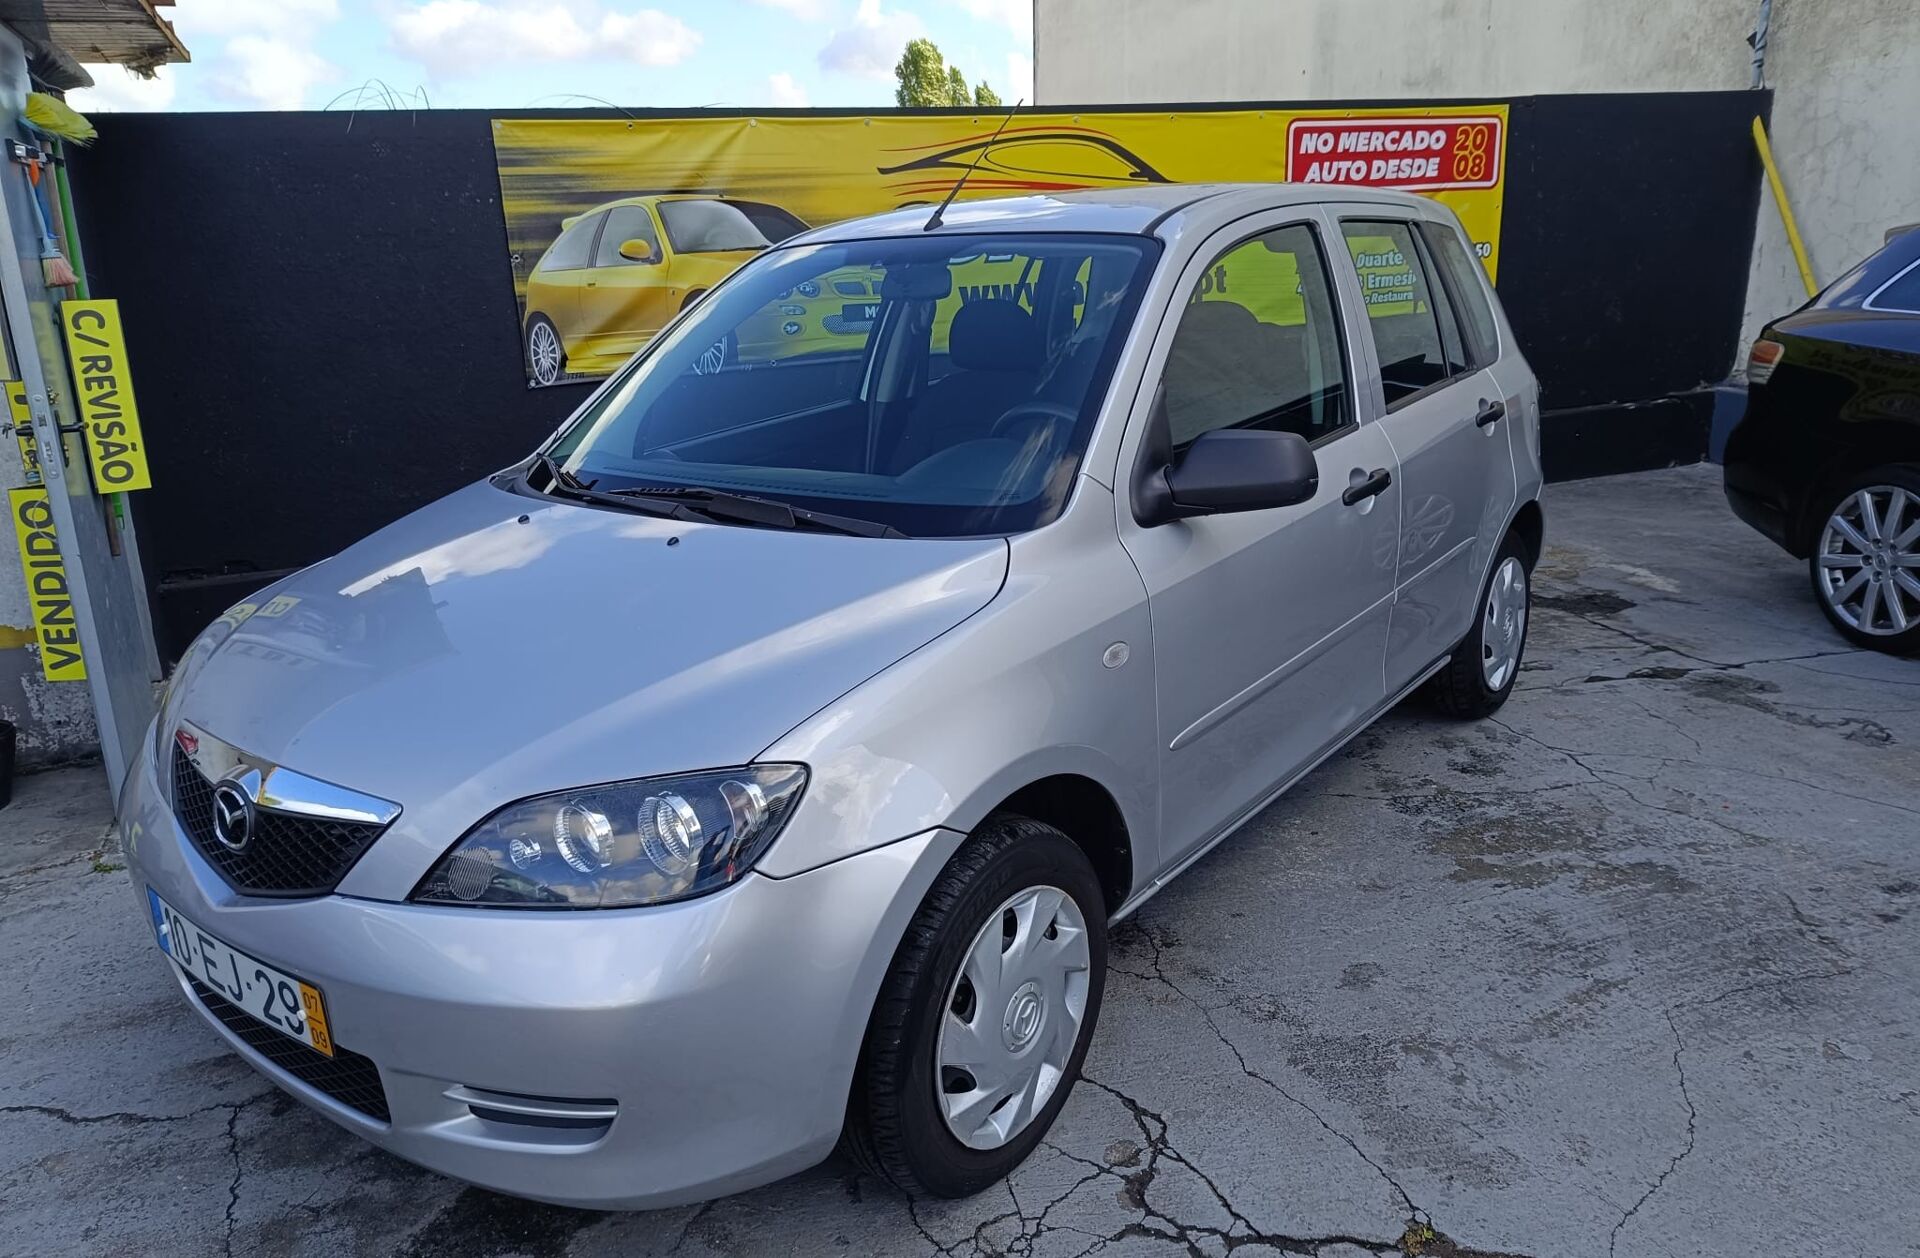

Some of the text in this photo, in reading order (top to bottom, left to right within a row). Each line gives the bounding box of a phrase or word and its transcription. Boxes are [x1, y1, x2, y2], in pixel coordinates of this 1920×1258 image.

[1300, 130, 1447, 154] NO MERCADO
[1454, 125, 1488, 154] 20
[1304, 157, 1440, 183] AUTO DESDE
[1453, 151, 1486, 180] 08
[71, 309, 139, 484] C/ REVISÃO
[18, 499, 82, 671] VENDIDO
[302, 991, 319, 1013] 07
[311, 1027, 328, 1049] 09
